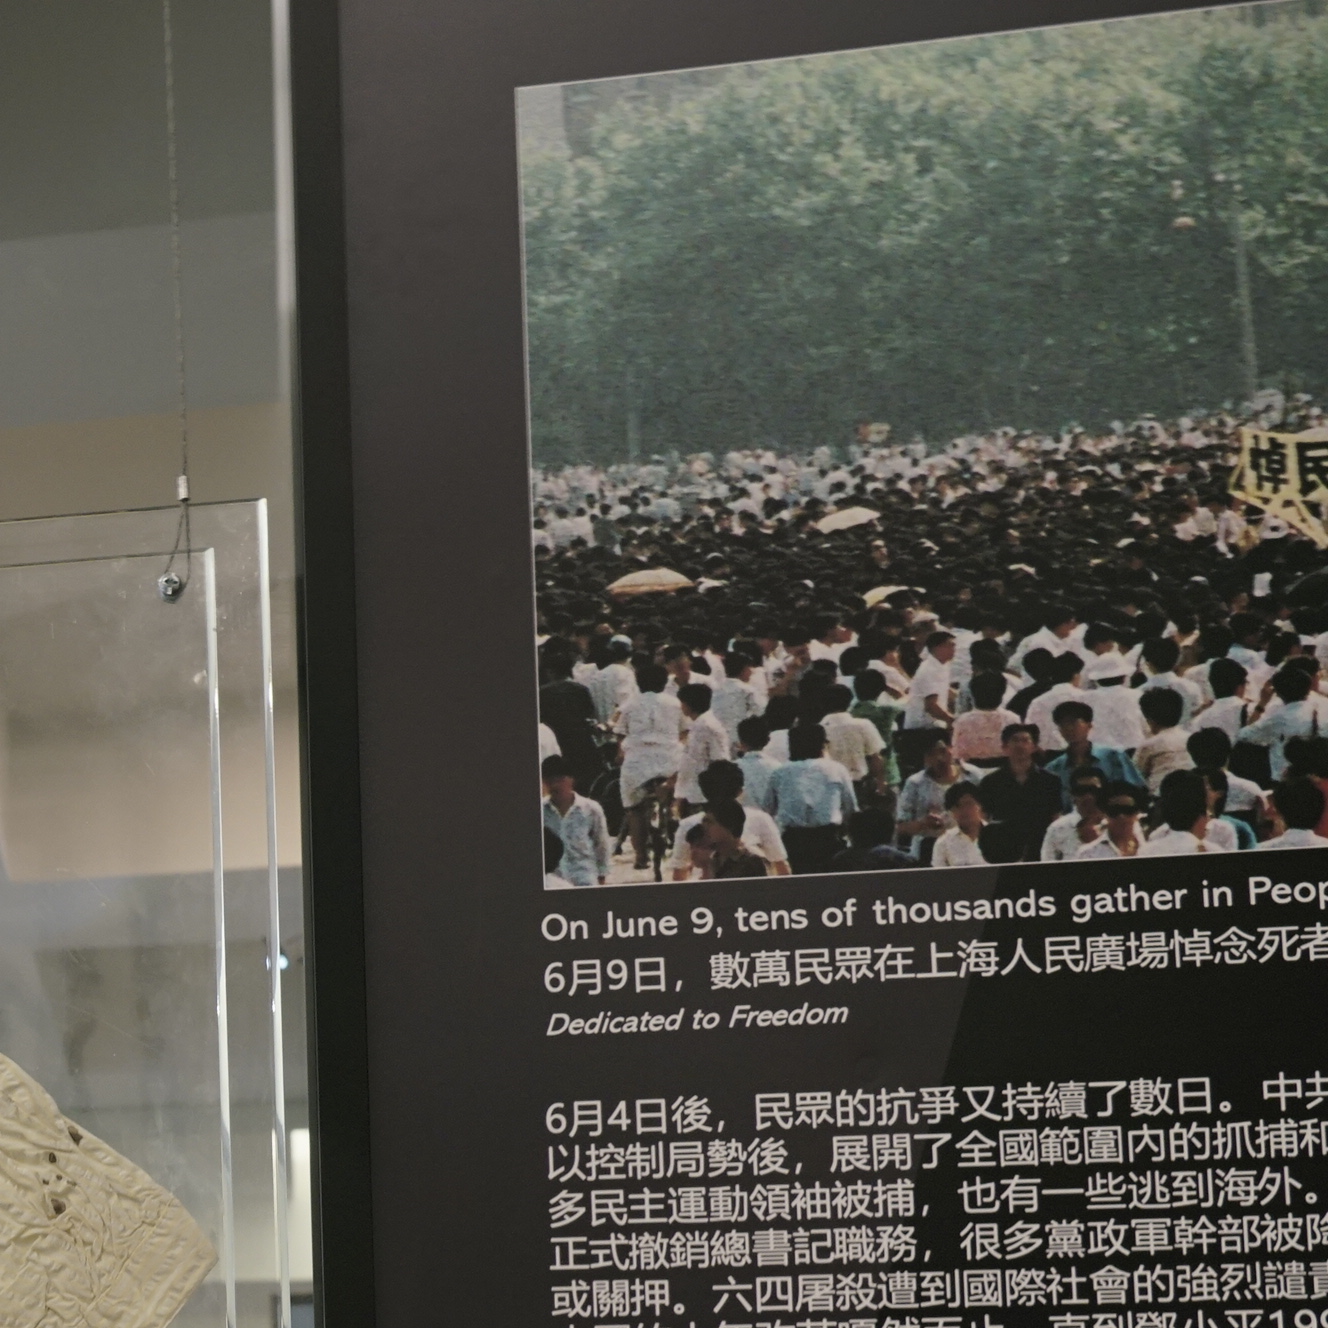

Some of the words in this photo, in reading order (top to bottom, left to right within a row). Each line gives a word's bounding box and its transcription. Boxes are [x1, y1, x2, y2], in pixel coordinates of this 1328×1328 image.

[541, 913, 588, 941] On
[602, 911, 678, 939] June
[691, 907, 723, 938] 9,
[734, 907, 808, 932] tens
[821, 898, 857, 927] of
[872, 889, 1056, 925] thousands
[1071, 883, 1188, 923] gather
[1202, 879, 1233, 908] in
[546, 1007, 685, 1036] Dedicated
[692, 1009, 720, 1030] to
[729, 1002, 849, 1028] Freedom
